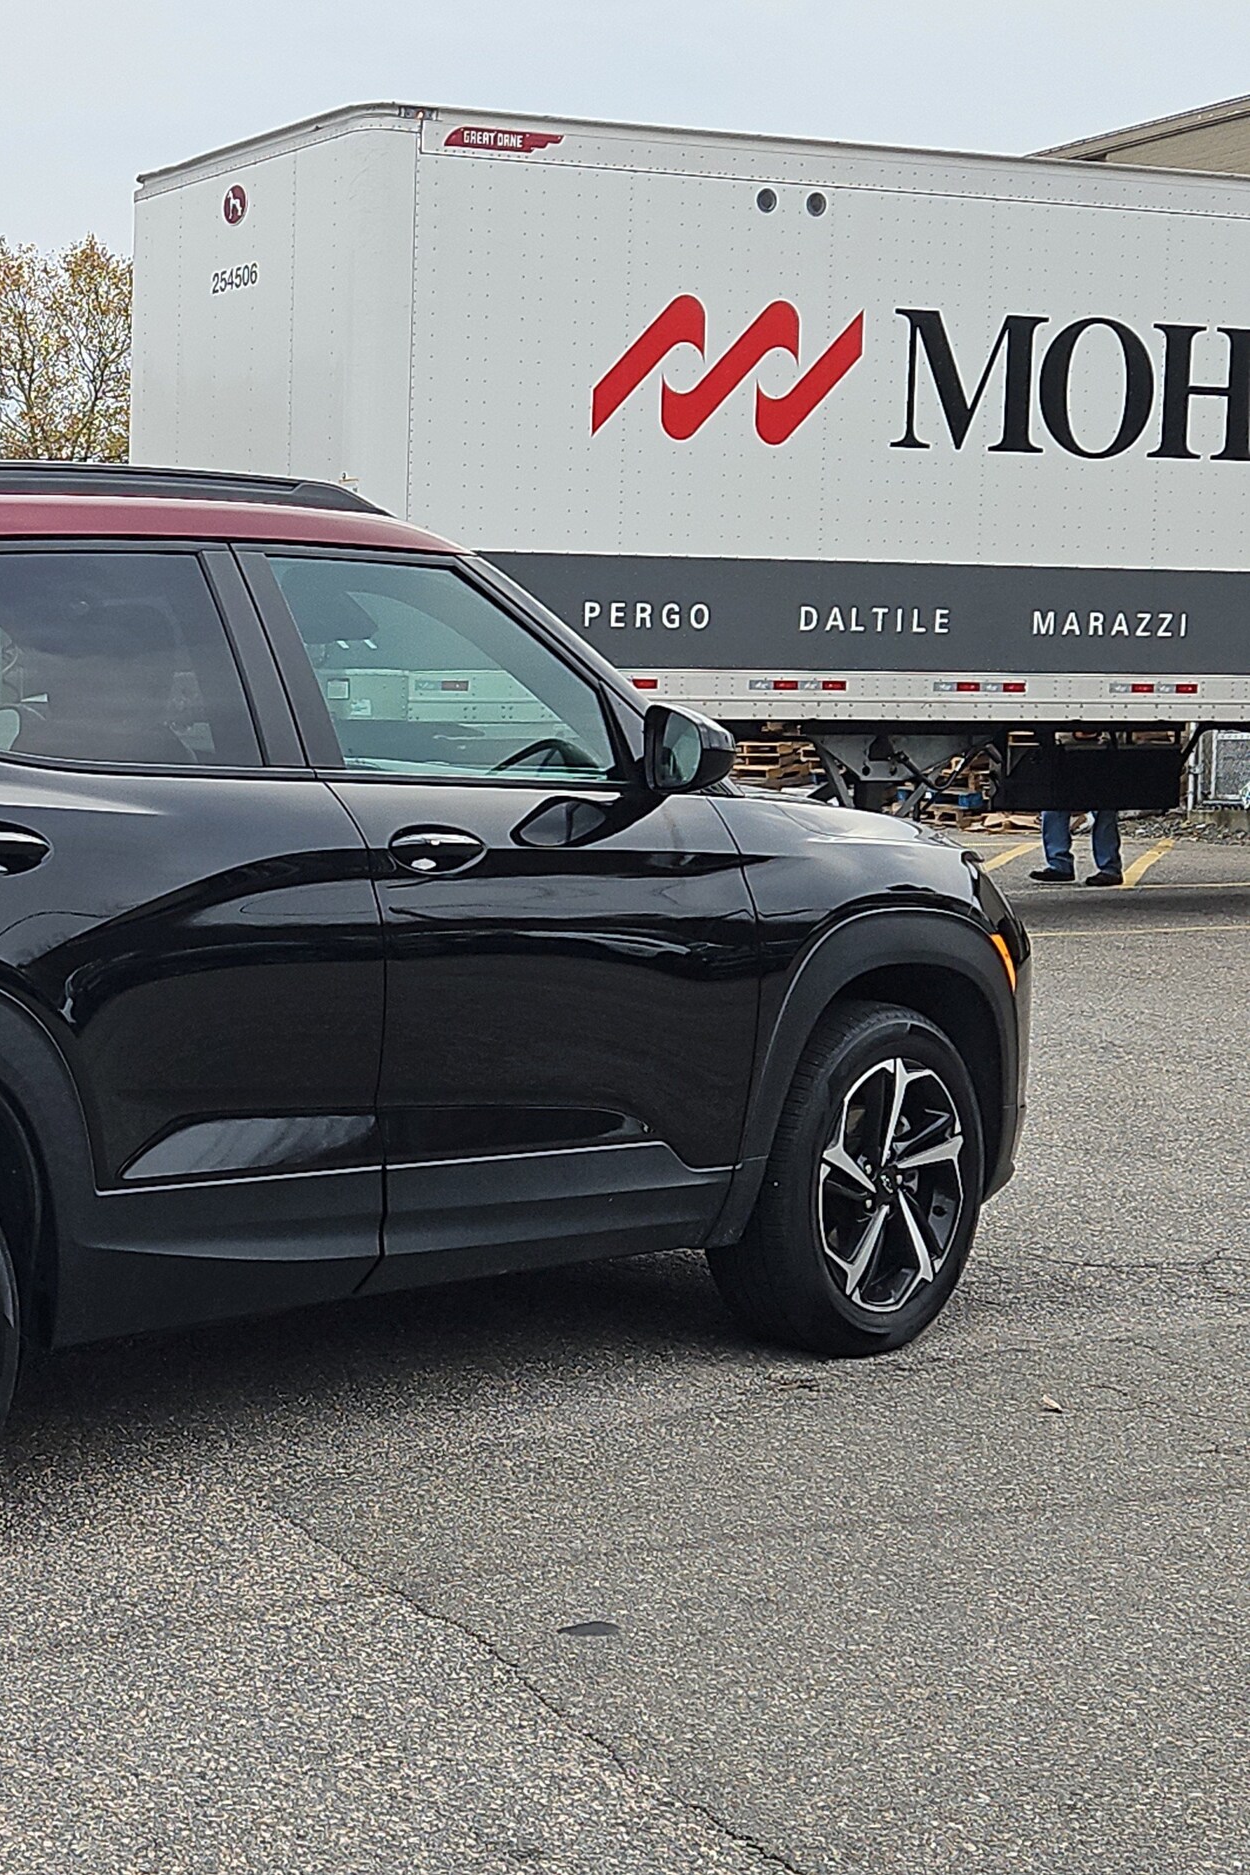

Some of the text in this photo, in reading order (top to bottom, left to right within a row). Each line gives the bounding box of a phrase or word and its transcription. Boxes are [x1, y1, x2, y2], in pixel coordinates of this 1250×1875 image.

[463, 130, 524, 148] GREAT DANE
[212, 262, 258, 294] 254506
[890, 307, 1250, 461] MOH
[583, 601, 1188, 637] PERGO DALTILE MARAZZI
